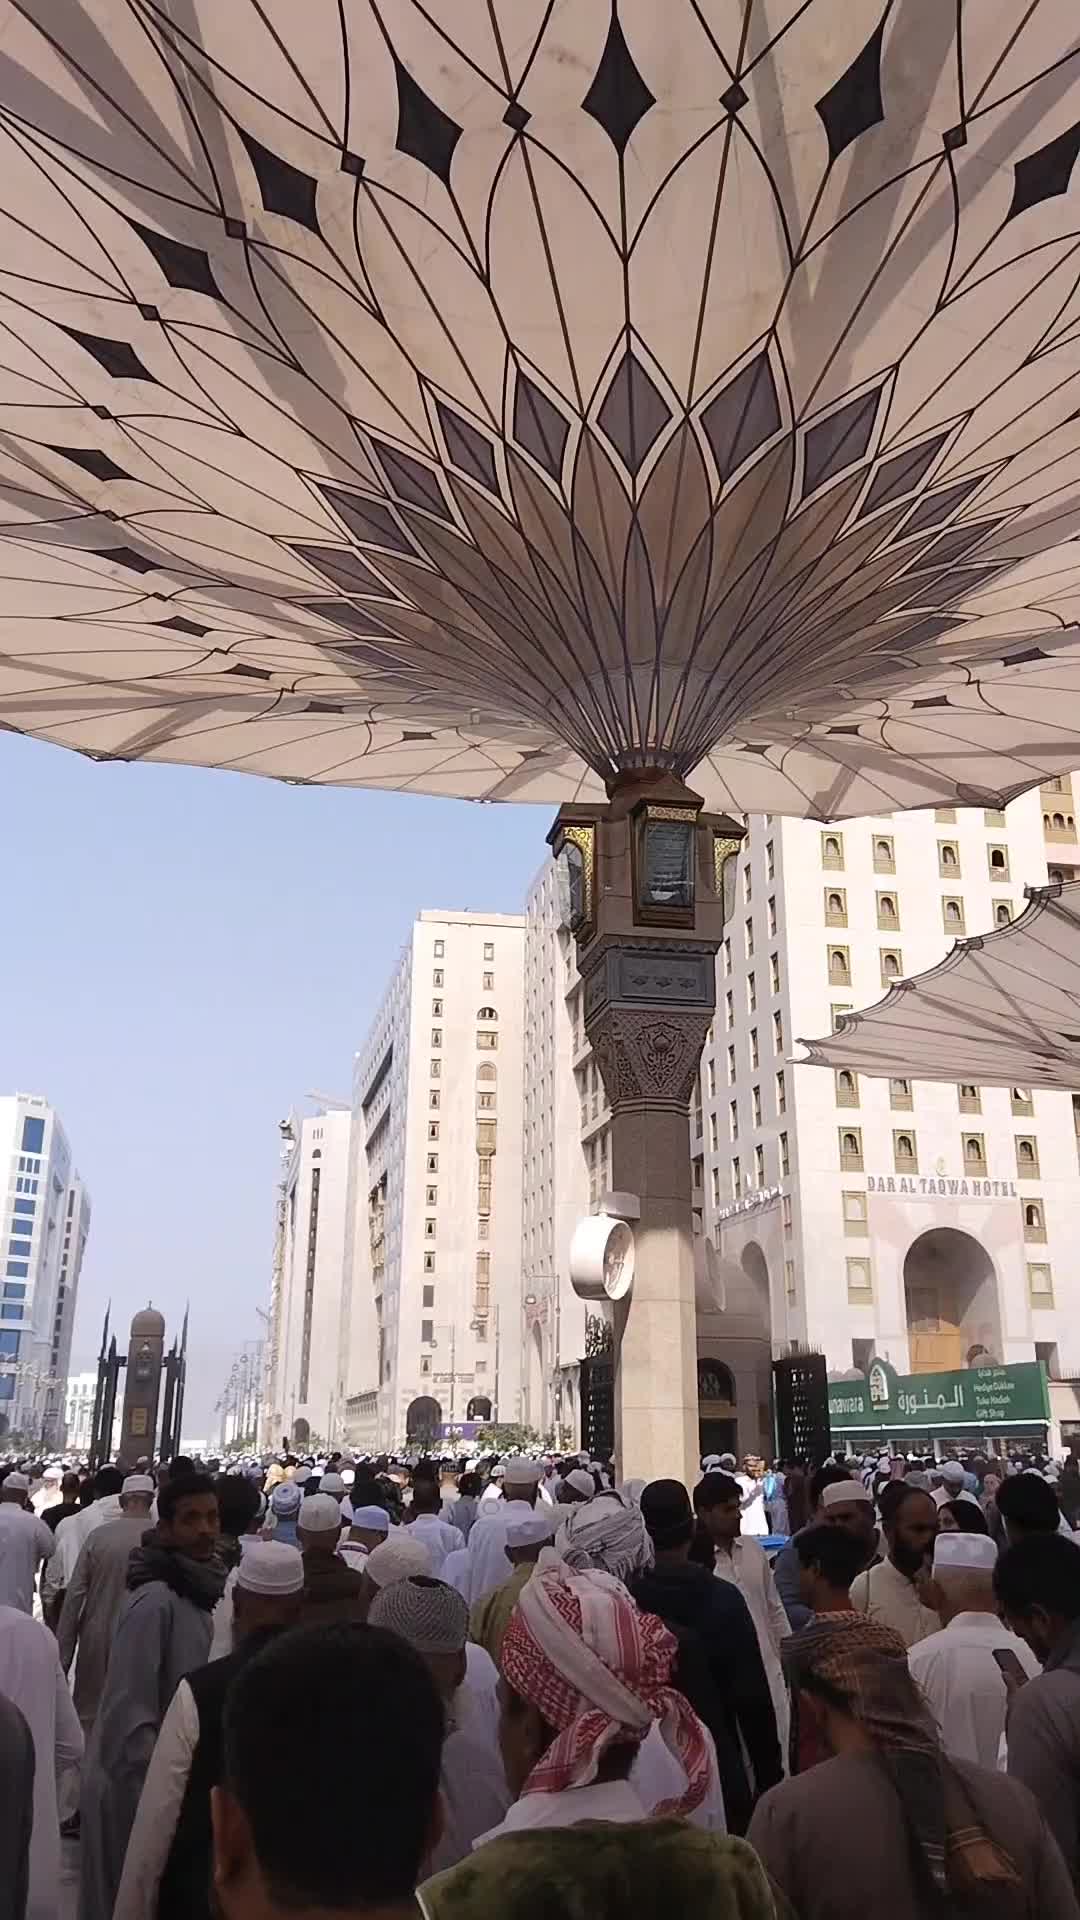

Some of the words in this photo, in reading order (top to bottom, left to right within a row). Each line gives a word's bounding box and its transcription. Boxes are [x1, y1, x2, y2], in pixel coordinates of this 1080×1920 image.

[867, 1176, 896, 1193] DAR
[900, 1177, 917, 1194] AL
[919, 1178, 969, 1196] TAQWA
[972, 1180, 1018, 1197] HOTEL
[828, 1396, 865, 1414] unawara
[898, 1384, 964, 1415] المنورة
